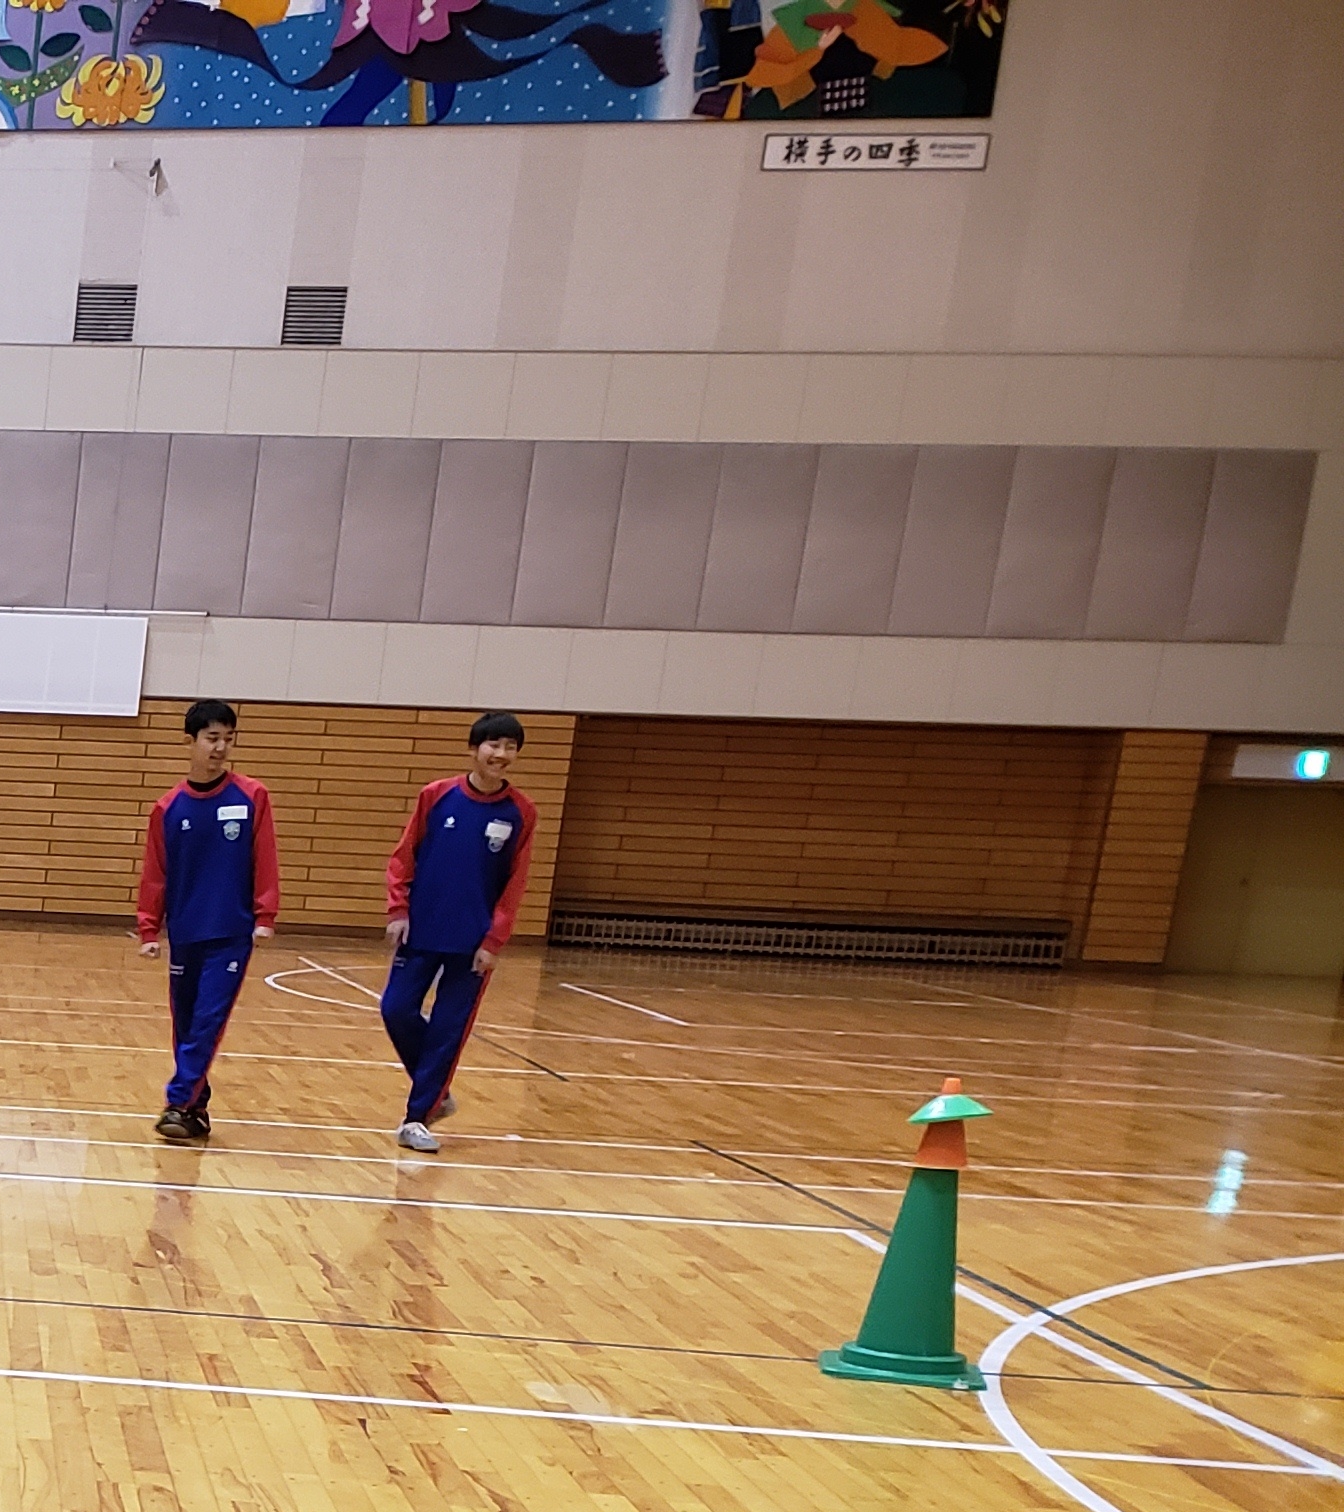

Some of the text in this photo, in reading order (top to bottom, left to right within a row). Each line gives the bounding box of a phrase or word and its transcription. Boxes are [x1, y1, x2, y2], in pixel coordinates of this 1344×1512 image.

[782, 137, 922, 167] 横手の四季
